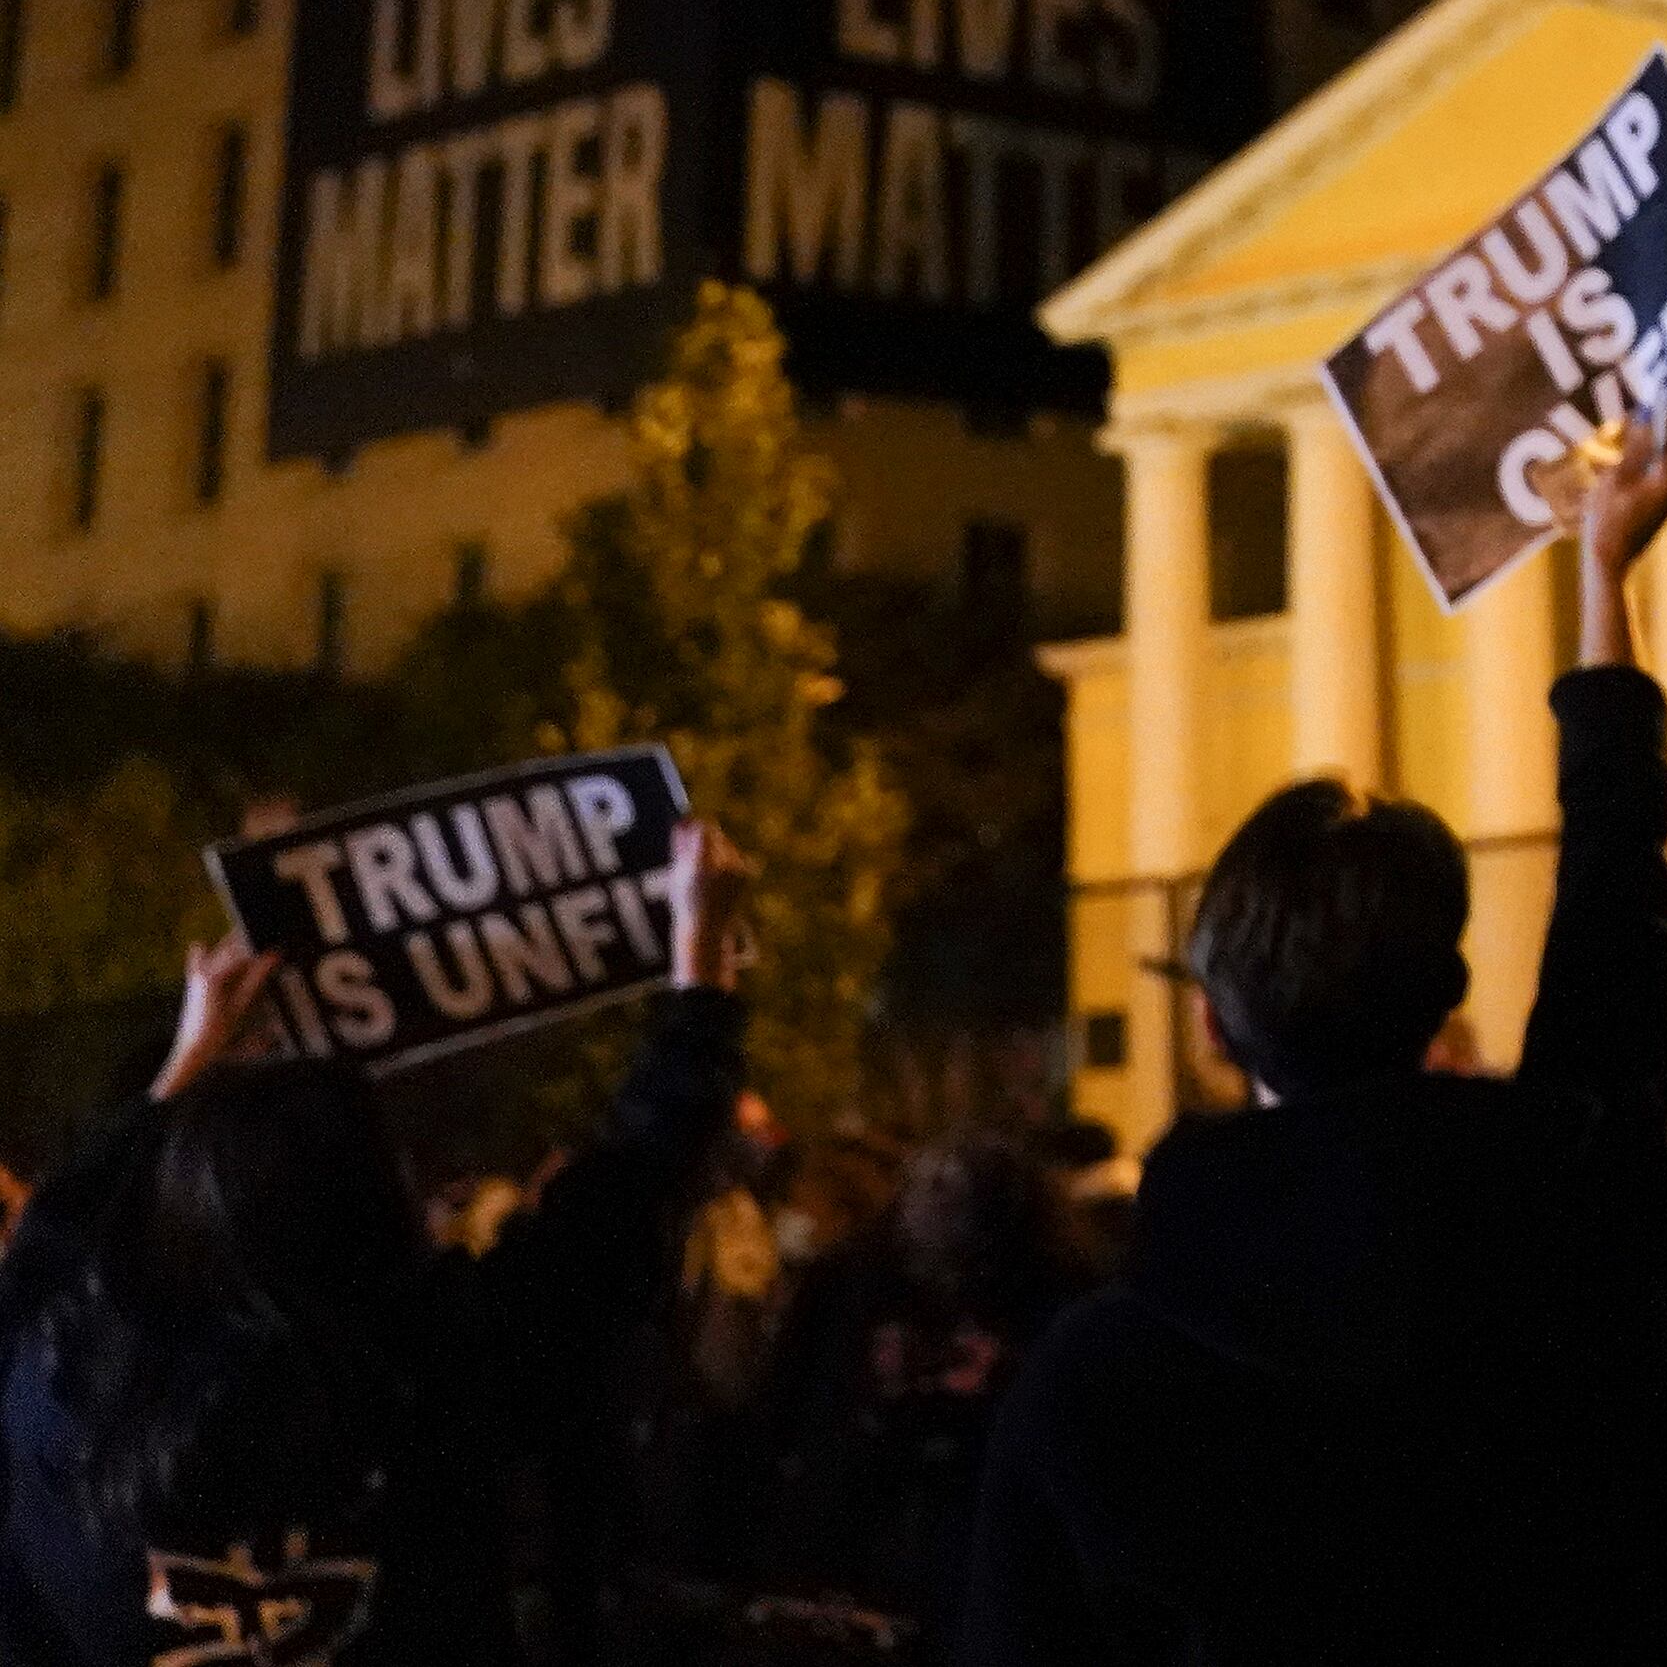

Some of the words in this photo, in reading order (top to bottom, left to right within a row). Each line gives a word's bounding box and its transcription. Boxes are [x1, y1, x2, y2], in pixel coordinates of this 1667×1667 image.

[299, 81, 669, 362] MATTER
[741, 75, 1215, 311] MATT
[1361, 90, 1661, 395] TRUMP
[1525, 266, 1638, 391] IS
[274, 773, 637, 944] TRUMP
[278, 949, 397, 1059] IS
